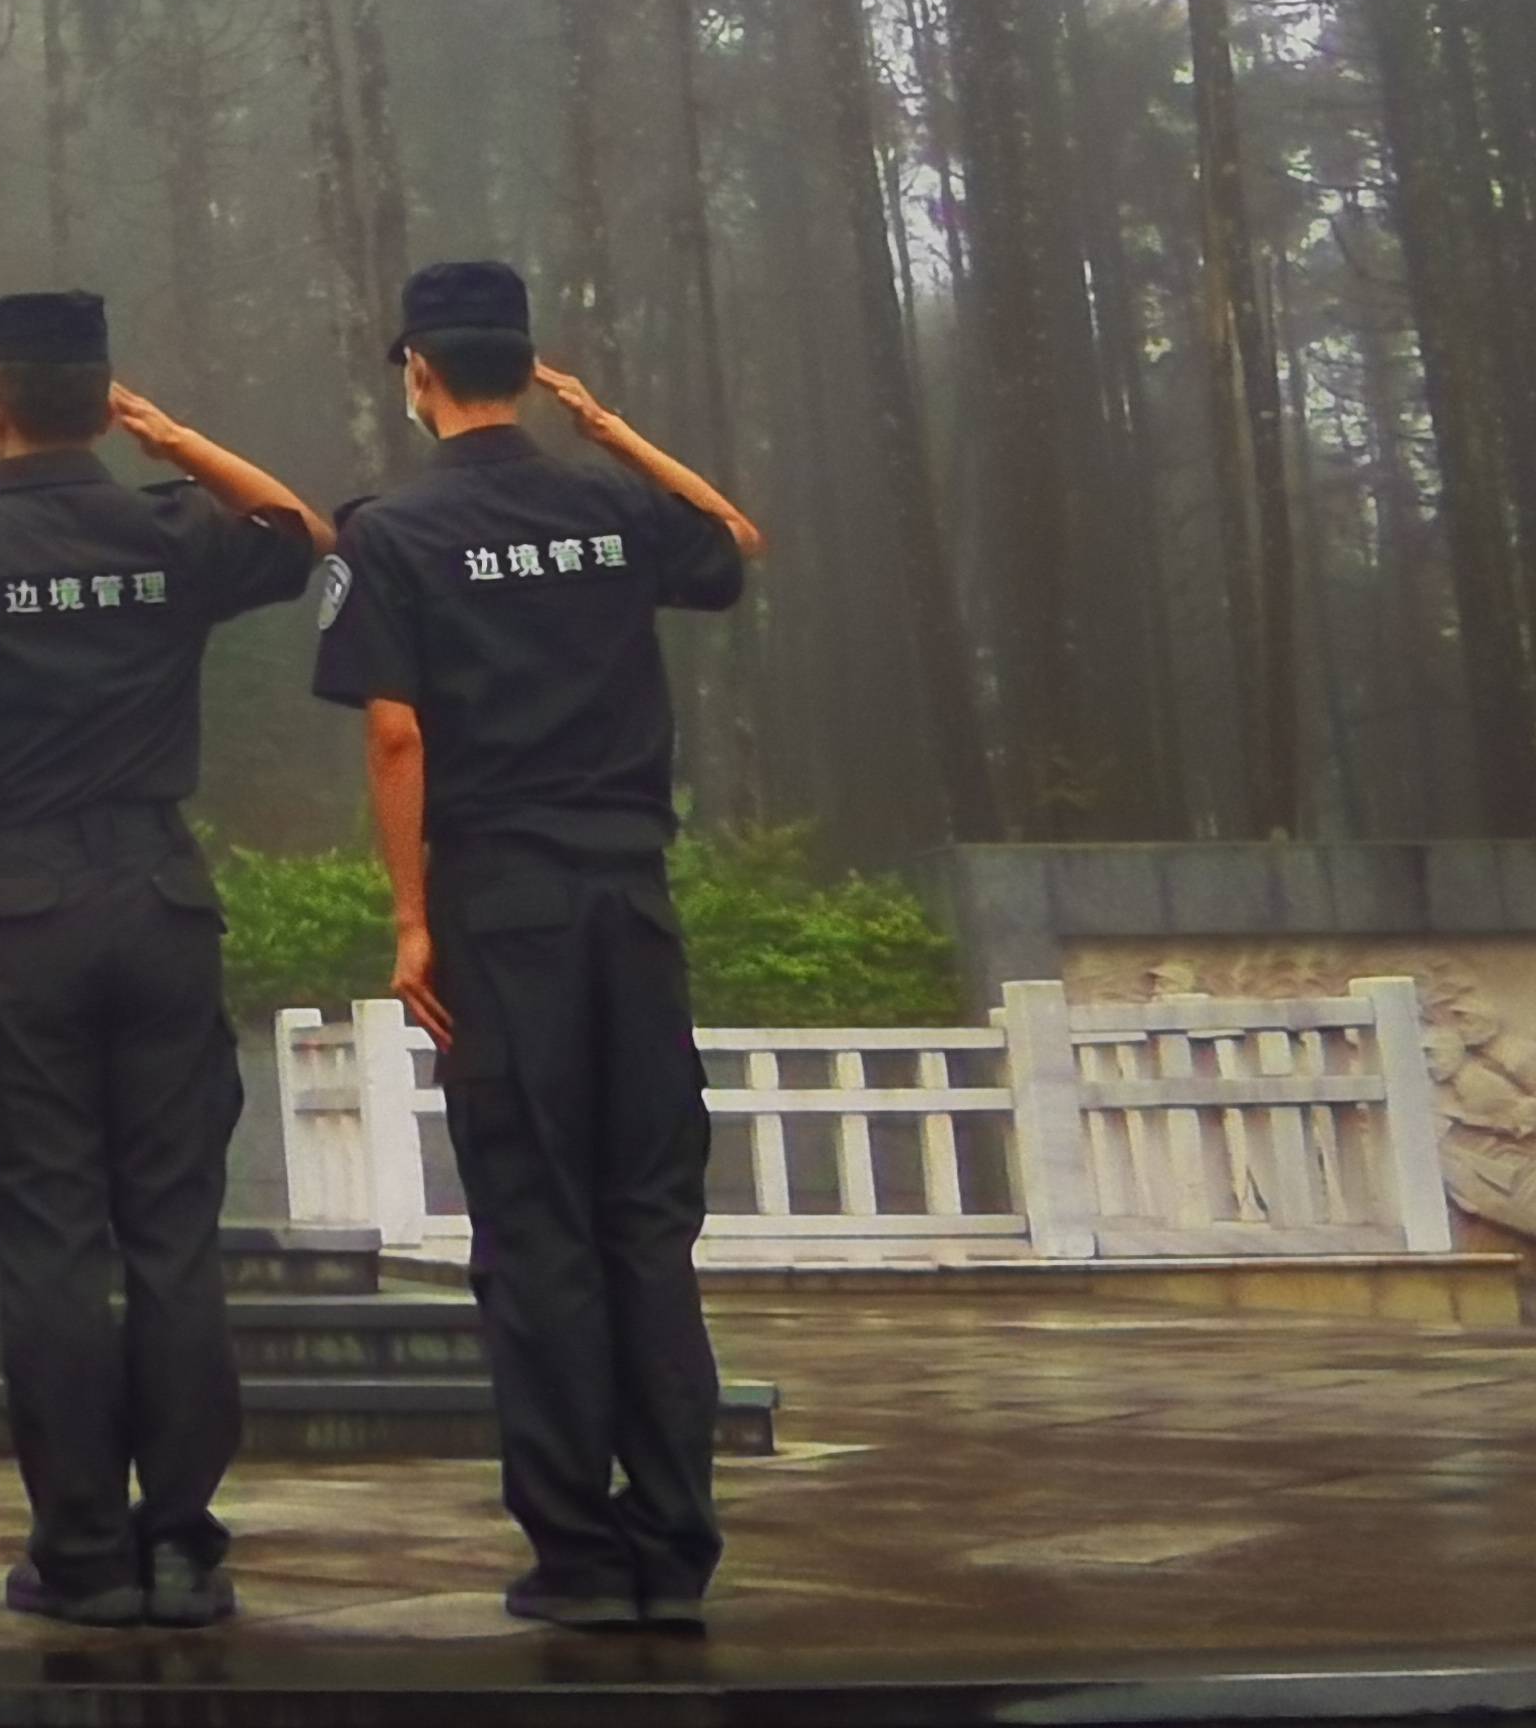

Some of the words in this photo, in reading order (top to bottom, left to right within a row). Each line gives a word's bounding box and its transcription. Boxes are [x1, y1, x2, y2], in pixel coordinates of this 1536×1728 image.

[464, 534, 627, 580] 边境管理
[4, 571, 167, 613] 边境管理
